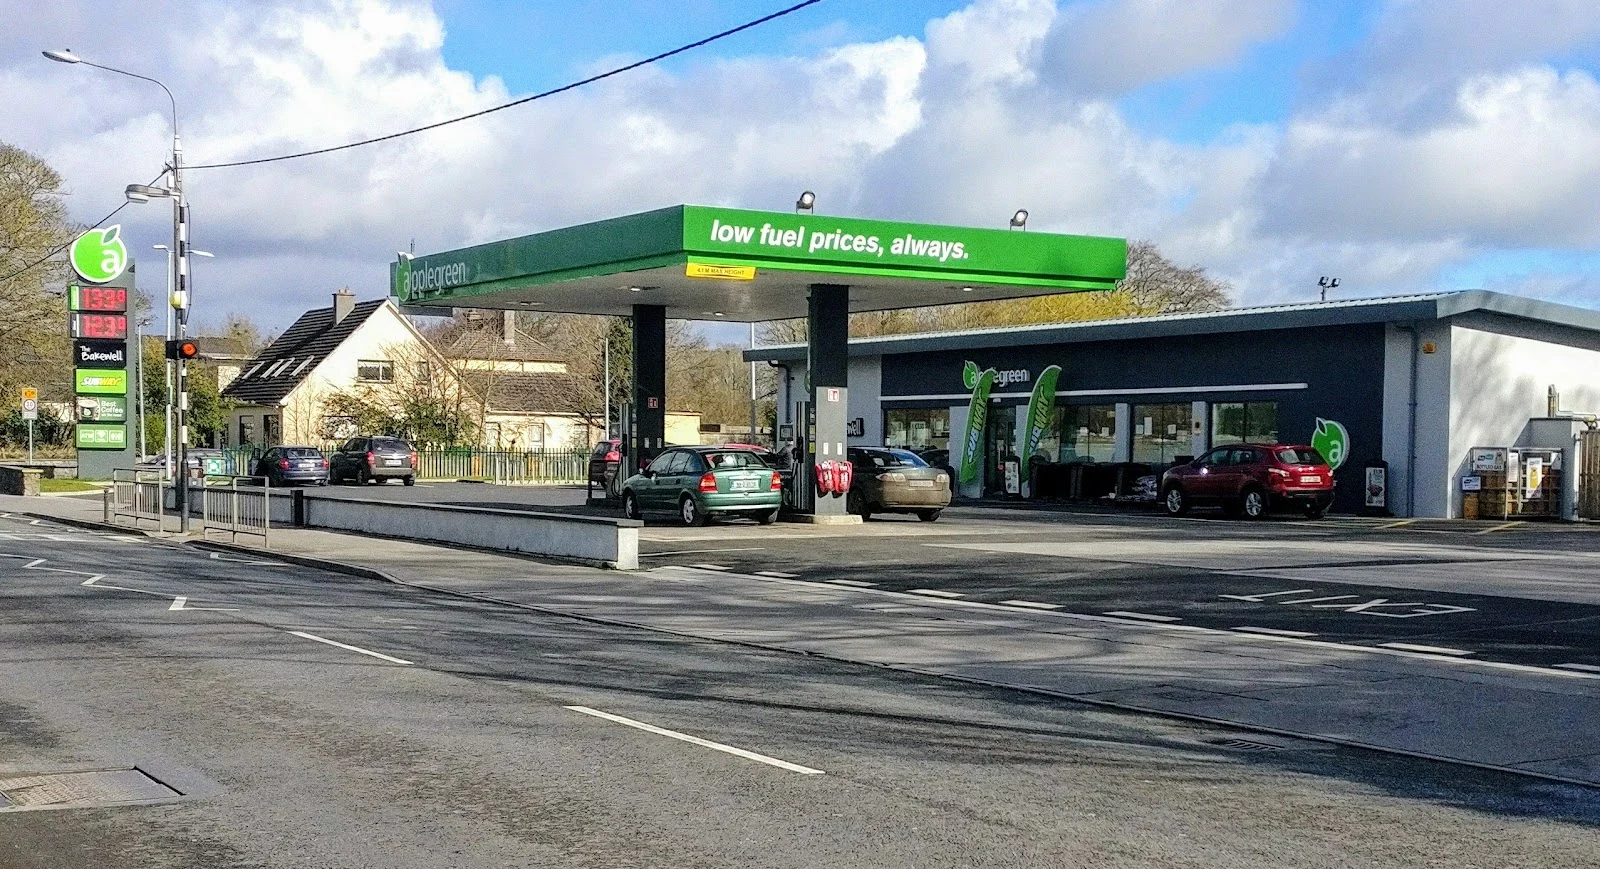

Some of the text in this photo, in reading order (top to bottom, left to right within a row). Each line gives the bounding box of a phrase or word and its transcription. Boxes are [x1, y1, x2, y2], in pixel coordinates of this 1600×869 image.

[711, 219, 969, 262] low fuel prices, always.
[404, 260, 467, 299] applegreen
[81, 350, 123, 361] Bakewell
[81, 376, 122, 386] SUBWAY
[101, 406, 124, 414] Coffee
[966, 387, 987, 464] SUBWAY
